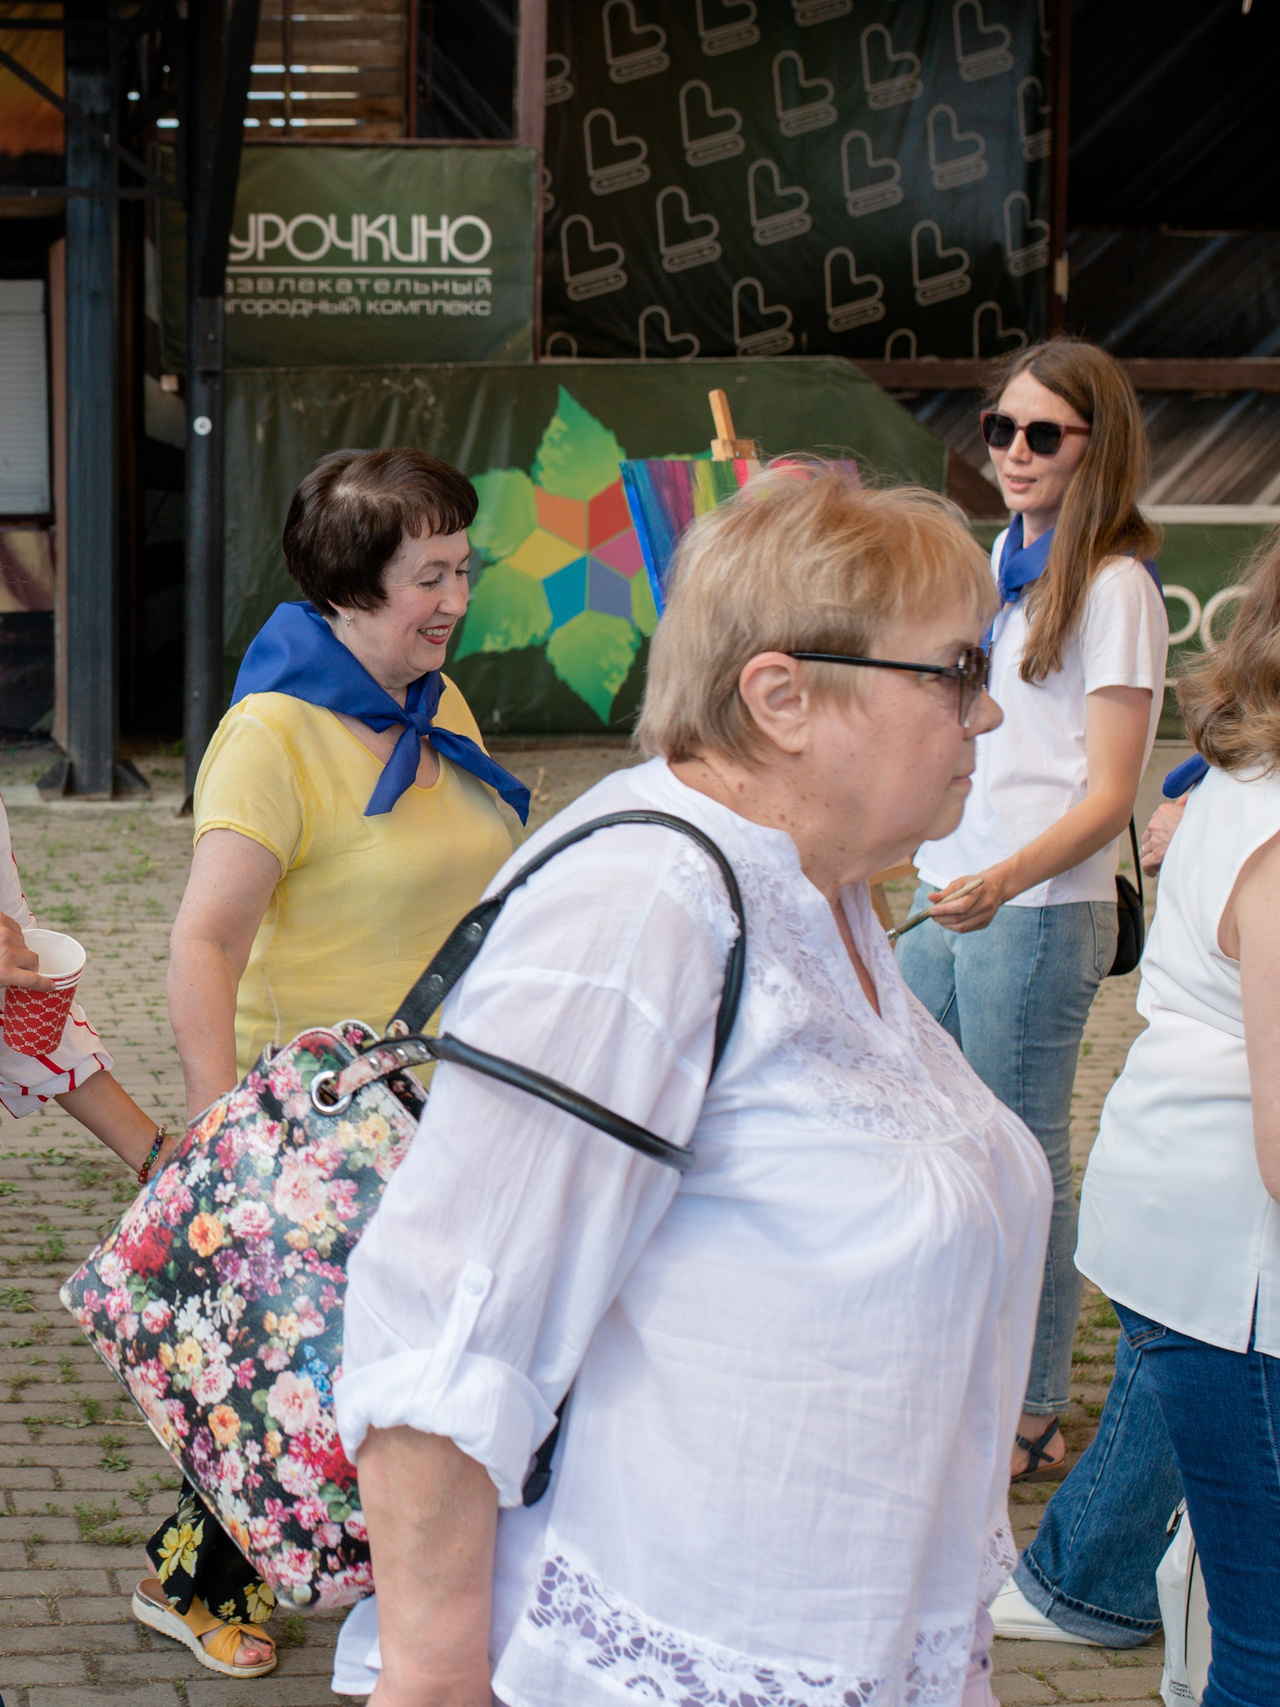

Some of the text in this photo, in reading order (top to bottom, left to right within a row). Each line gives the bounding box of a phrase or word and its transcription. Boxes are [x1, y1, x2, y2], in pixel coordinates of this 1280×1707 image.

[228, 213, 492, 263] УРОЧКИНО
[225, 297, 492, 319] городный комплекс
